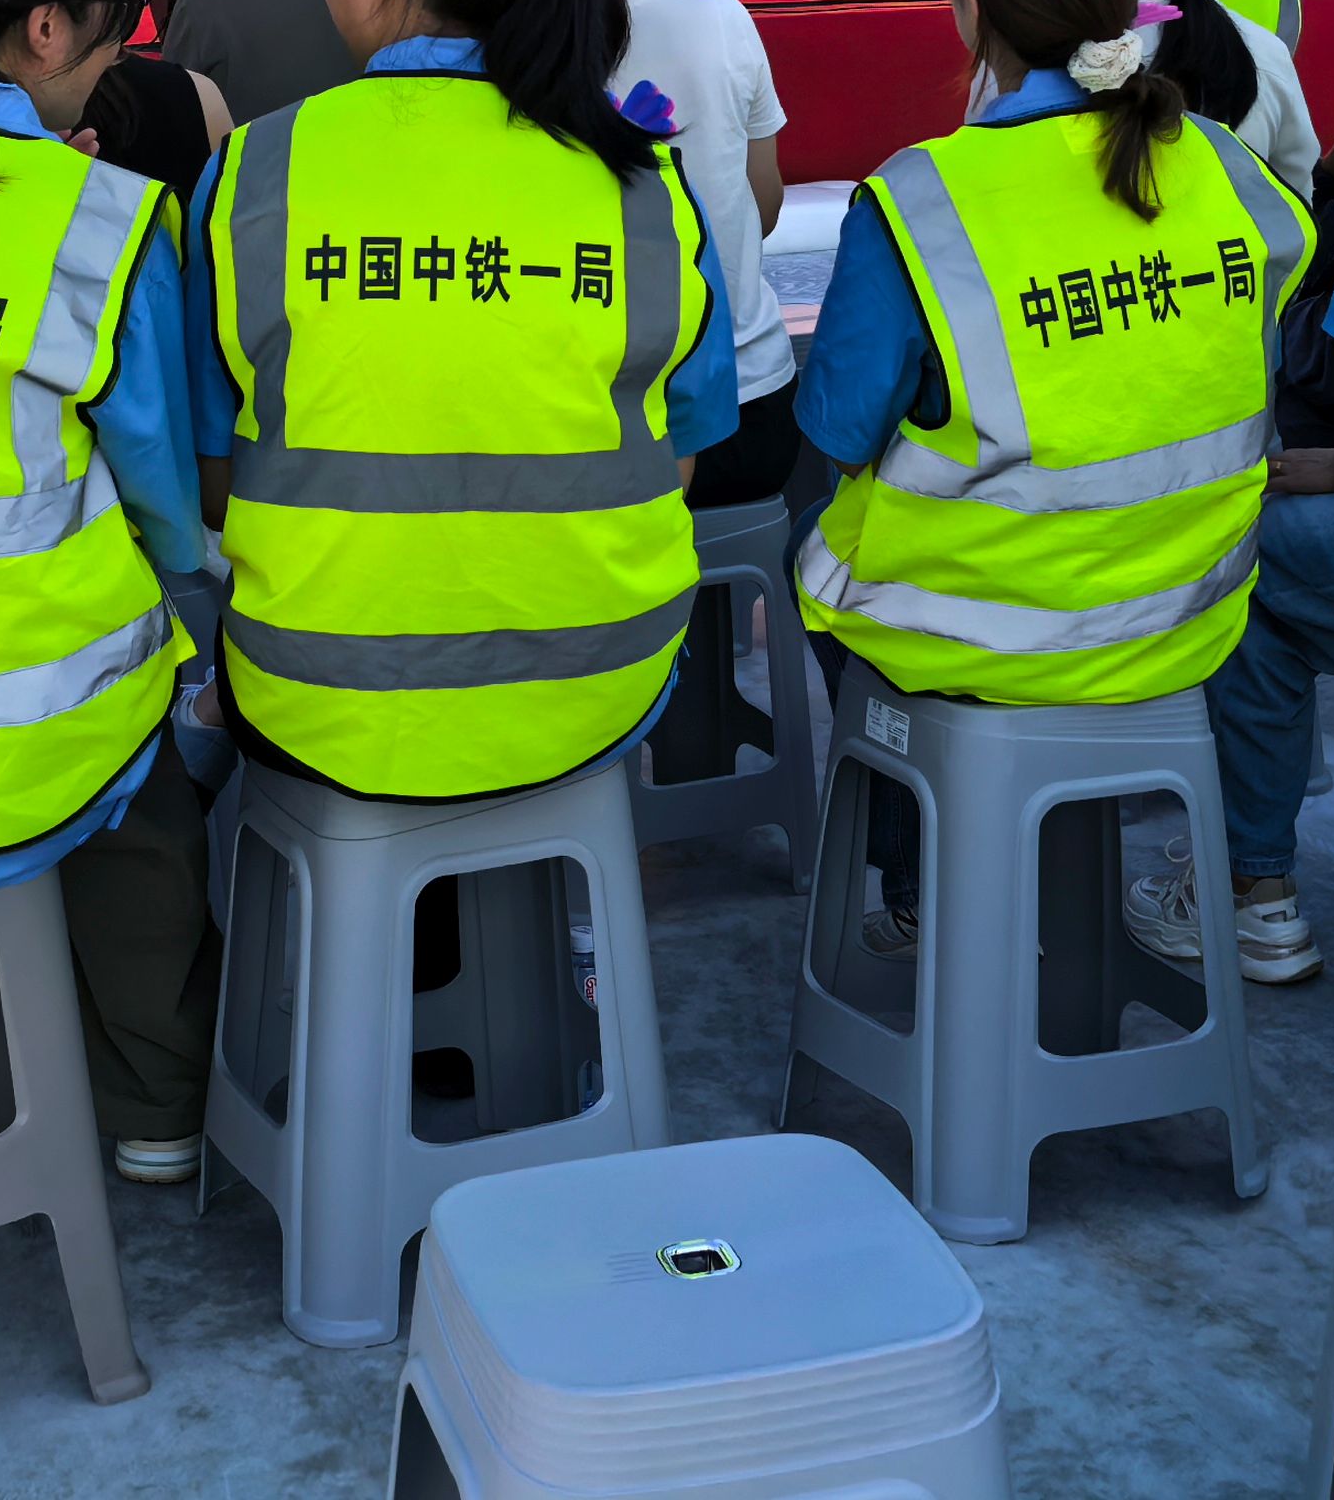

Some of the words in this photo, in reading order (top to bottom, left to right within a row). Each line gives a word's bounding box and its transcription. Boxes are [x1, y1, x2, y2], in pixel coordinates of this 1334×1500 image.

[304, 233, 614, 308] 中国中铁一局
[1019, 237, 1257, 348] 中国中铁一局
